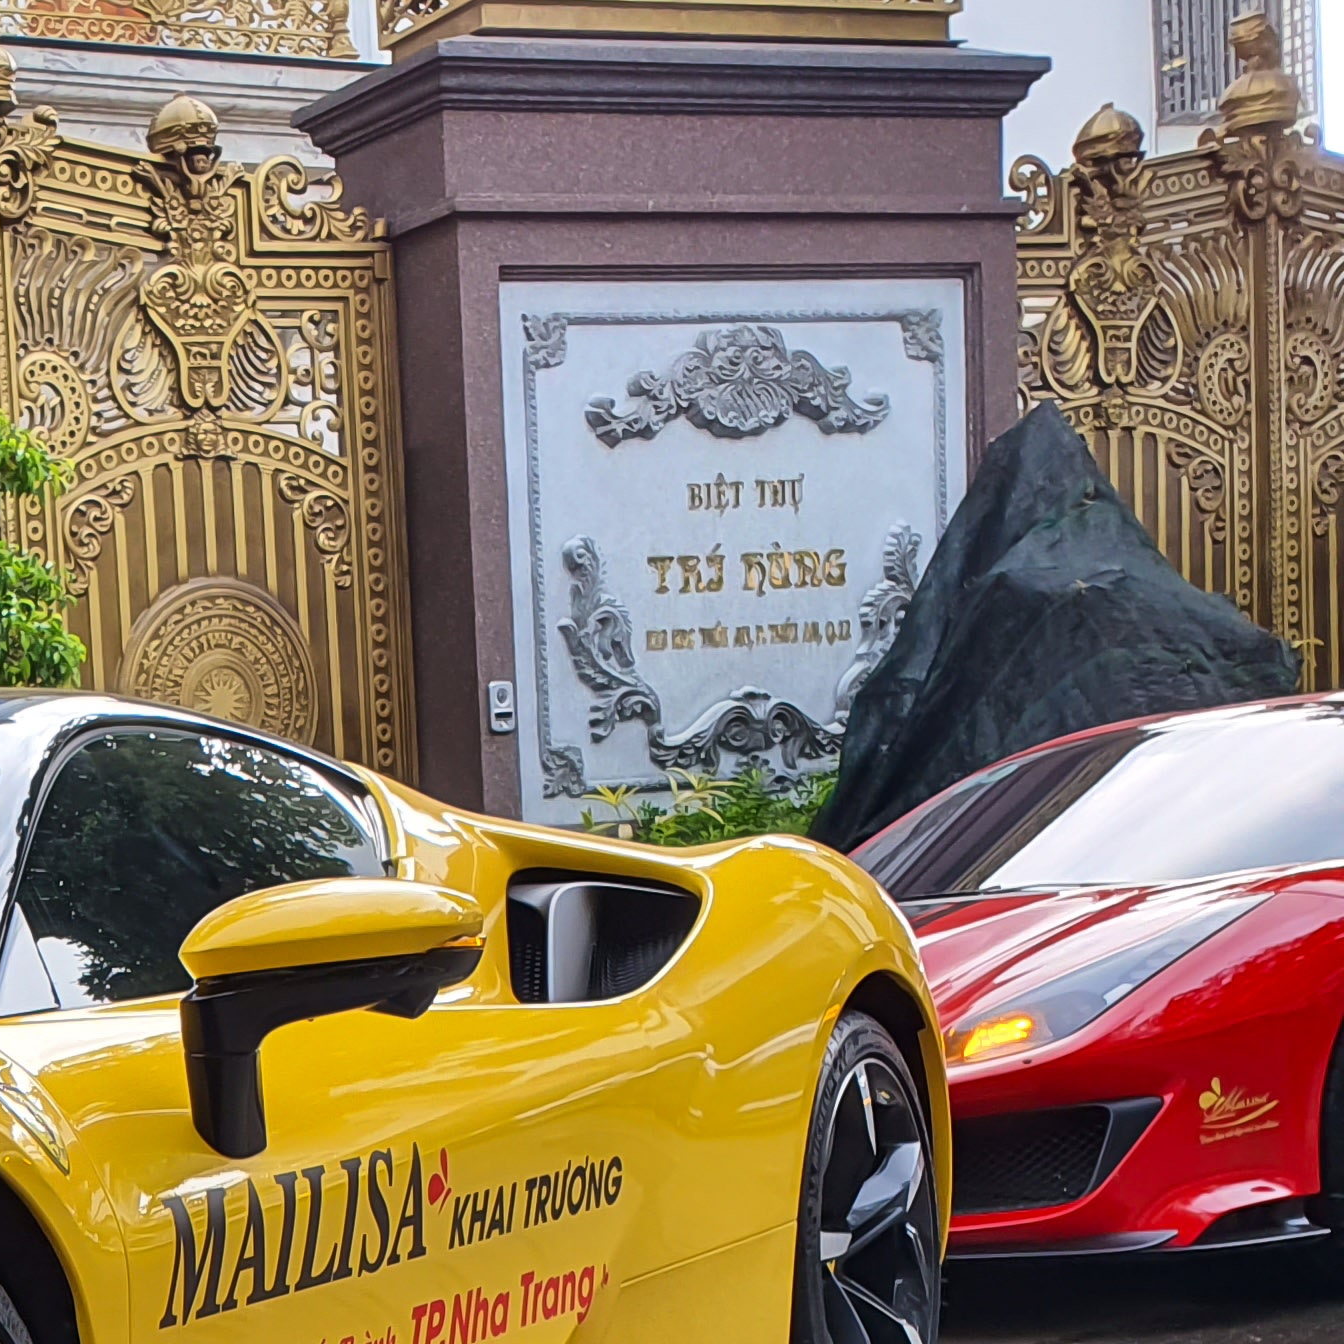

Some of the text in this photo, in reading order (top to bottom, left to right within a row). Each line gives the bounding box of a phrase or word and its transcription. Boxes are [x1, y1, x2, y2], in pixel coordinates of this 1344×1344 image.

[687, 472, 744, 517] BIỆT
[647, 541, 847, 597] TRÍ HÙNG
[159, 1141, 623, 1330] MAILISA KHAI TRƯƠNG
[520, 1264, 596, 1325] Trang
